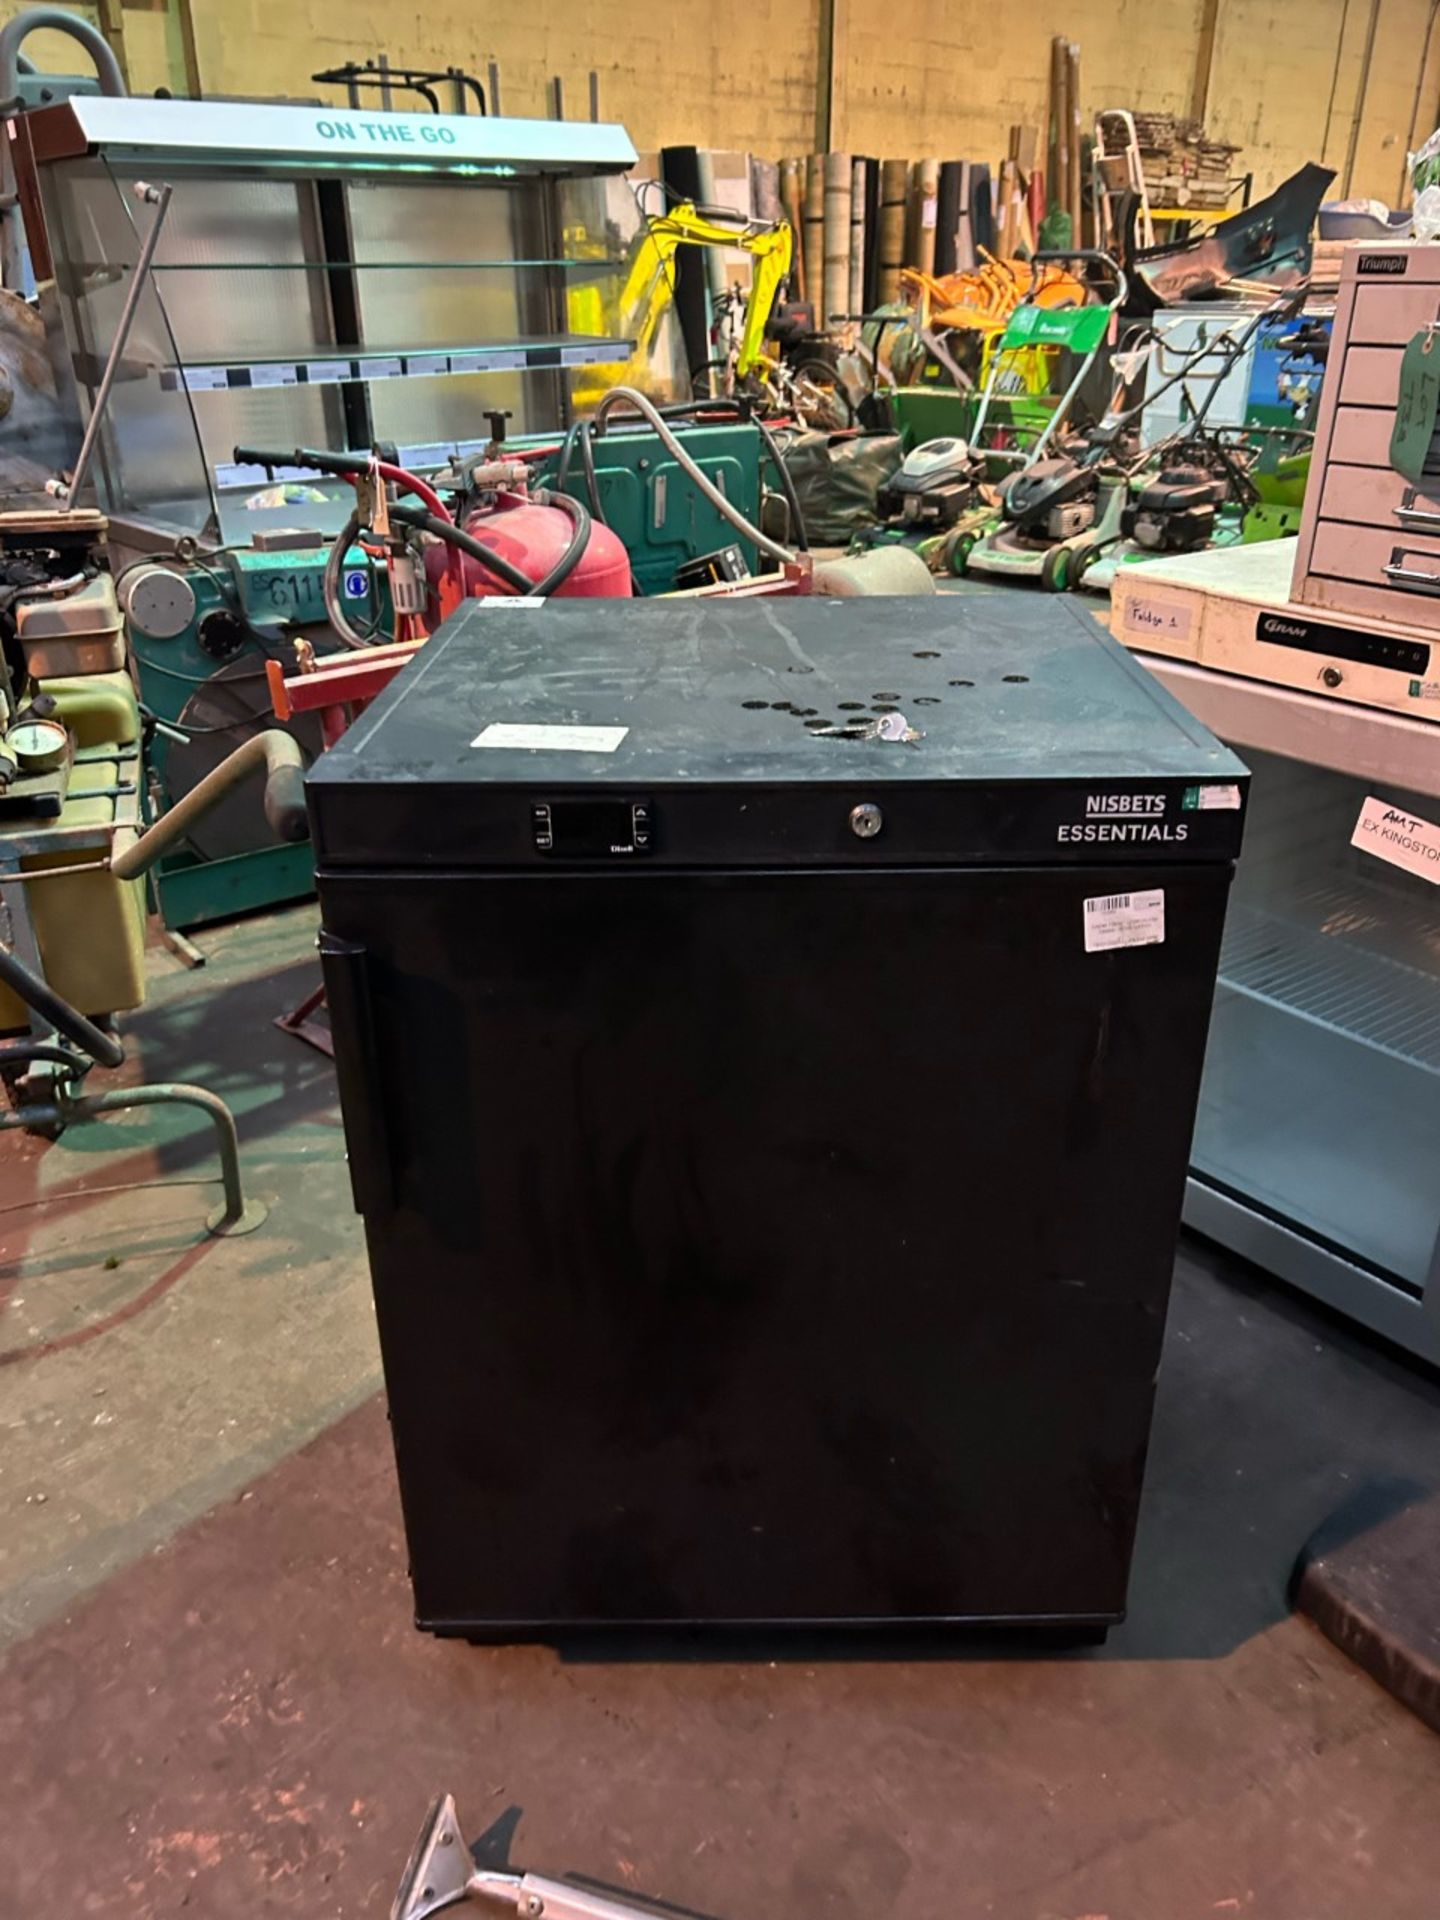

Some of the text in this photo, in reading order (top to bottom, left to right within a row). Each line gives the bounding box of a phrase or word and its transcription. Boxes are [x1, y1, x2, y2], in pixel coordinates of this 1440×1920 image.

[316, 121, 456, 144] ON THE GO
[1086, 795, 1166, 813] NISBETS
[1057, 824, 1188, 842] ESSENTIALS
[1362, 818, 1380, 834] EX
